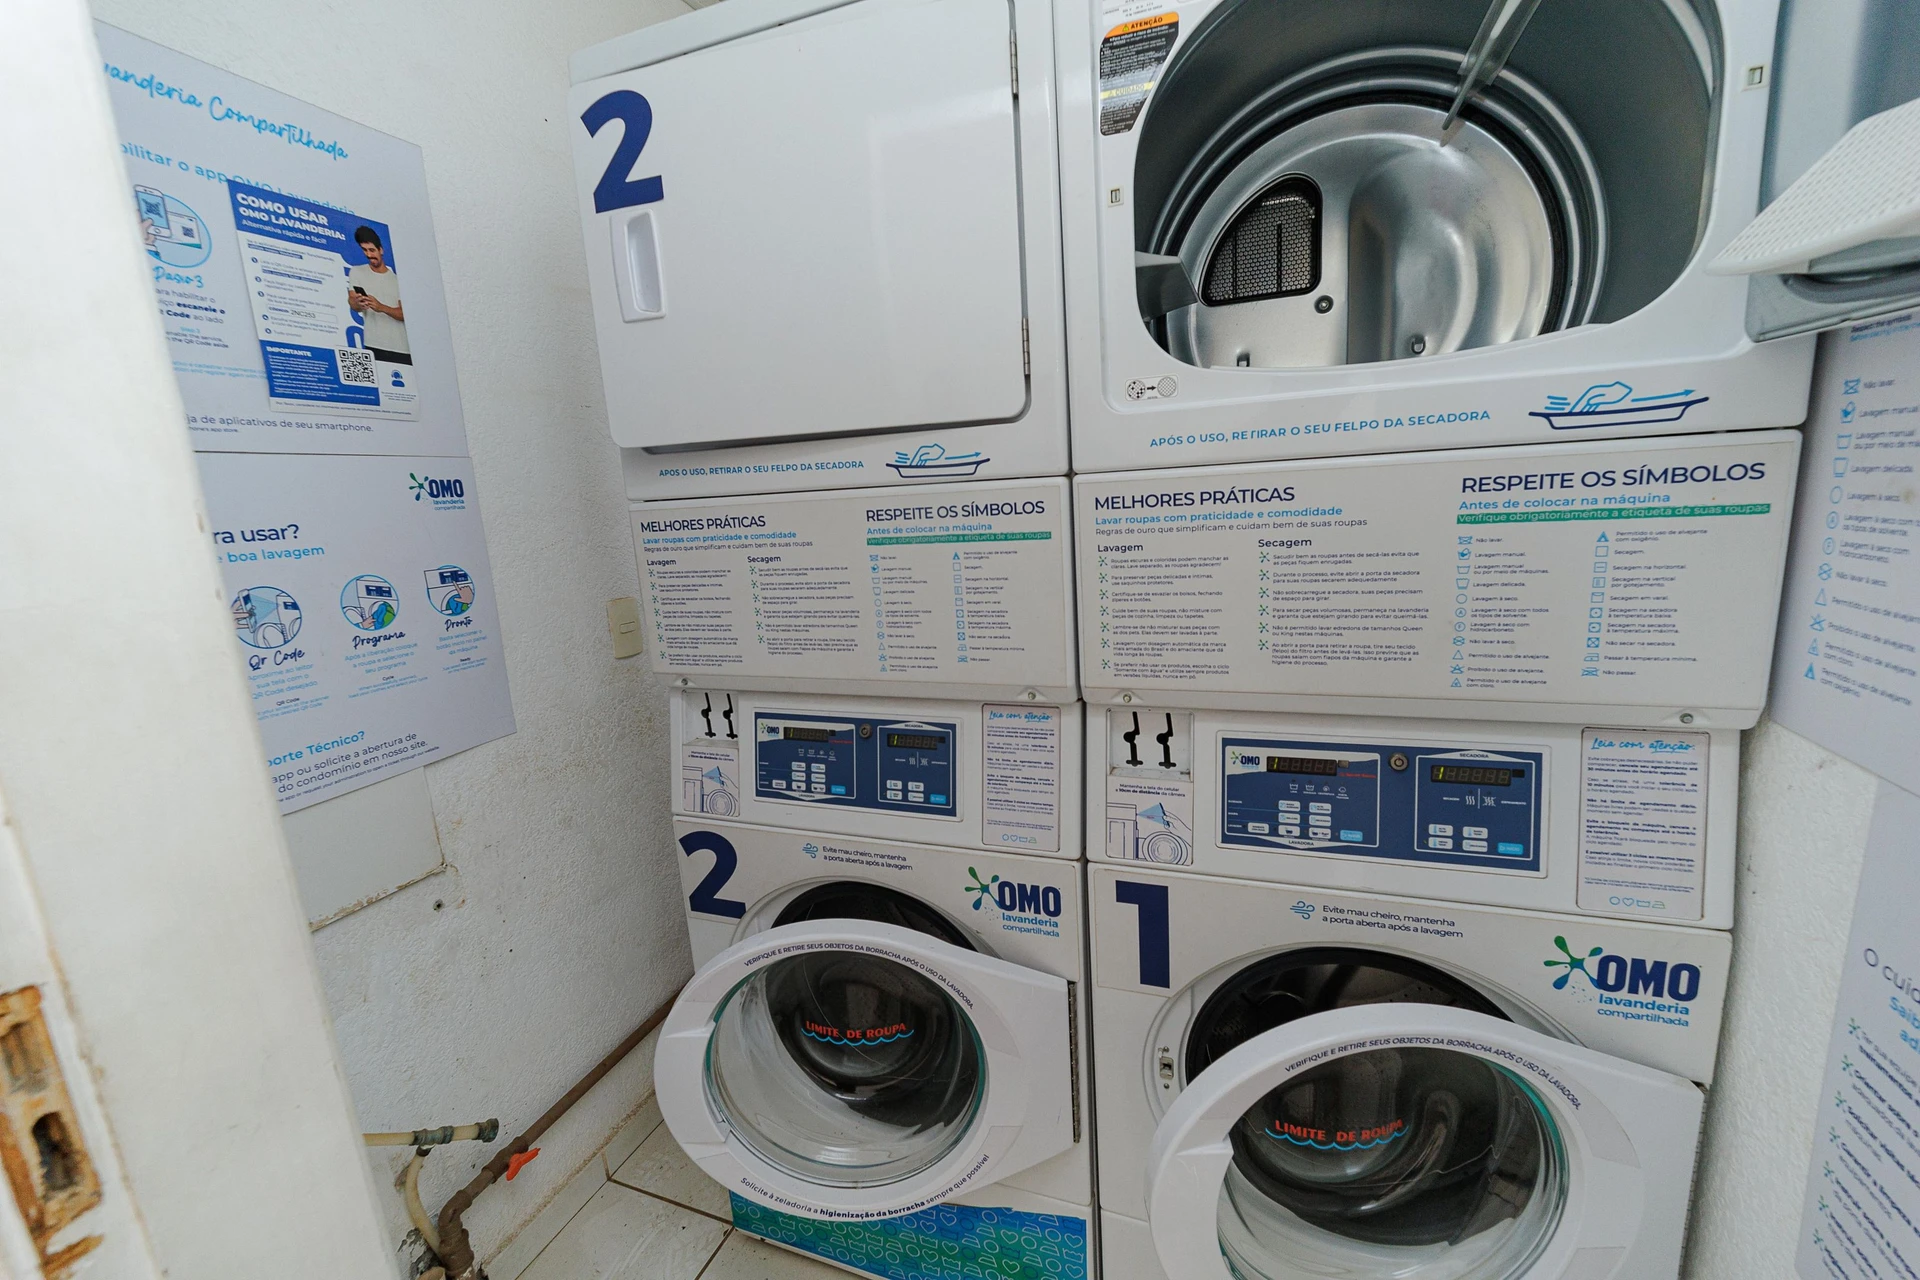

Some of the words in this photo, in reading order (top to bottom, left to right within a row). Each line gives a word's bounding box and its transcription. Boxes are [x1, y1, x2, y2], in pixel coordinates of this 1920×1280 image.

[1130, 16, 1163, 29] ATENÇÃO
[580, 89, 664, 214] 2
[194, 165, 228, 184] app
[236, 193, 285, 214] COMO
[288, 206, 328, 226] USAR
[238, 206, 269, 221] OMO
[270, 214, 346, 240] LAVANDERIA:
[194, 275, 204, 288] 3
[166, 310, 190, 318] Code
[176, 302, 218, 313] escaneie
[266, 346, 312, 357] IMPORTANTE
[1149, 434, 1183, 447] APÓS
[1186, 435, 1196, 444] O
[1199, 432, 1228, 442] USO,
[1232, 427, 1286, 440] RETIRAR
[1290, 426, 1300, 436] O
[1303, 423, 1331, 434] SEU
[1334, 419, 1379, 432] FELPO
[1383, 417, 1404, 428] DA
[1407, 410, 1490, 426] SECADORA
[681, 468, 688, 476] O
[688, 467, 708, 476] USO,
[708, 466, 743, 475] RETIRAR
[744, 465, 751, 473] O
[752, 465, 769, 473] SEU
[770, 463, 798, 472] FELPO
[800, 463, 813, 471] DA
[814, 460, 864, 470] SECADORA
[1461, 472, 1575, 493] RESPEITE
[1580, 470, 1616, 488] OS
[1622, 462, 1765, 486] SÍMBOLOS
[428, 478, 464, 498] OMO
[1095, 491, 1195, 510] MELHORES
[1200, 486, 1295, 505] PRÁTICAS
[1458, 501, 1498, 510] Antes
[1502, 498, 1520, 509] de
[1523, 497, 1576, 508] colocar
[1580, 497, 1598, 505] na
[1603, 492, 1670, 506] máquina
[866, 506, 934, 522] RESPEITE
[936, 505, 958, 518] OS
[961, 500, 1045, 518] SÍMBOLOS
[1095, 517, 1122, 525] Lavar
[1125, 515, 1161, 525] roupas
[1190, 510, 1254, 523] praticidade
[1267, 506, 1343, 518] comodidade
[1458, 512, 1508, 523] Verifique
[1509, 510, 1609, 521] obrigatoriamente
[1621, 508, 1672, 518] etiqueta
[1674, 507, 1691, 517] de
[1692, 506, 1722, 516] suas
[1724, 504, 1769, 515] roupas
[240, 523, 299, 542] usar?
[640, 518, 704, 532] MELHORES
[706, 515, 766, 529] PRÁTICAS
[1095, 528, 1123, 536] Regras
[1175, 523, 1226, 533] simplificam
[1235, 522, 1270, 530] cuidam
[1334, 519, 1368, 527] roupas
[1097, 544, 1144, 553] Lavagem
[1258, 538, 1312, 549] Secagem
[227, 551, 257, 562] boa
[261, 547, 325, 560] lavagem
[646, 558, 676, 566] Lavagem
[747, 554, 781, 564] Secagem
[444, 616, 473, 632] Pronto
[352, 631, 406, 650] Programa
[249, 654, 267, 671] Qr
[274, 648, 305, 666] Code
[1591, 737, 1615, 750] Leia
[1649, 740, 1696, 751] atenção:
[296, 766, 312, 776] ou
[313, 753, 351, 771] solicite
[361, 737, 403, 756] abertura
[404, 733, 417, 742] de
[277, 783, 294, 793] do
[296, 761, 361, 787] condomínio
[362, 755, 380, 766] em
[381, 746, 409, 759] nosso
[409, 740, 428, 751] site.
[678, 830, 746, 919] 2
[998, 881, 1061, 916] OMO
[1002, 913, 1058, 928] lavanderia
[1322, 904, 1345, 914] Evite
[1346, 909, 1369, 917] mau
[1370, 910, 1402, 922] cheiro,
[1403, 915, 1455, 927] mantenha
[1002, 923, 1060, 938] compartilhada
[1115, 880, 1170, 988] 1
[1329, 916, 1354, 925] porta
[1355, 918, 1386, 929] aberta
[1387, 923, 1411, 932] após
[1420, 926, 1463, 938] lavagem
[1864, 948, 1878, 967] O
[1597, 955, 1700, 1002] OMO
[1598, 994, 1690, 1015] lavanderia
[1597, 1008, 1690, 1027] compartilhada
[806, 1021, 839, 1038] LIMITE
[846, 1028, 862, 1039] DE
[866, 1022, 906, 1038] ROUPA
[1284, 1050, 1328, 1072] VERIFIQUE
[1337, 1040, 1367, 1052] RETIRE
[1368, 1038, 1391, 1046] SEUS
[1446, 1039, 1492, 1053] BORRACHA
[1493, 1048, 1516, 1061] APÓS
[1522, 1061, 1539, 1072] USO
[1537, 1068, 1550, 1079] DA
[1275, 1120, 1326, 1141] LIMITE
[1336, 1131, 1356, 1142] DE
[1361, 1119, 1403, 1141] ROUPA
[740, 1177, 768, 1196] Solicite
[774, 1196, 812, 1212] zeladoria
[819, 1208, 875, 1220] higienização
[887, 1201, 925, 1215] borracha
[925, 1186, 953, 1204] sempre
[953, 1177, 967, 1189] que
[966, 1154, 989, 1180] possível
